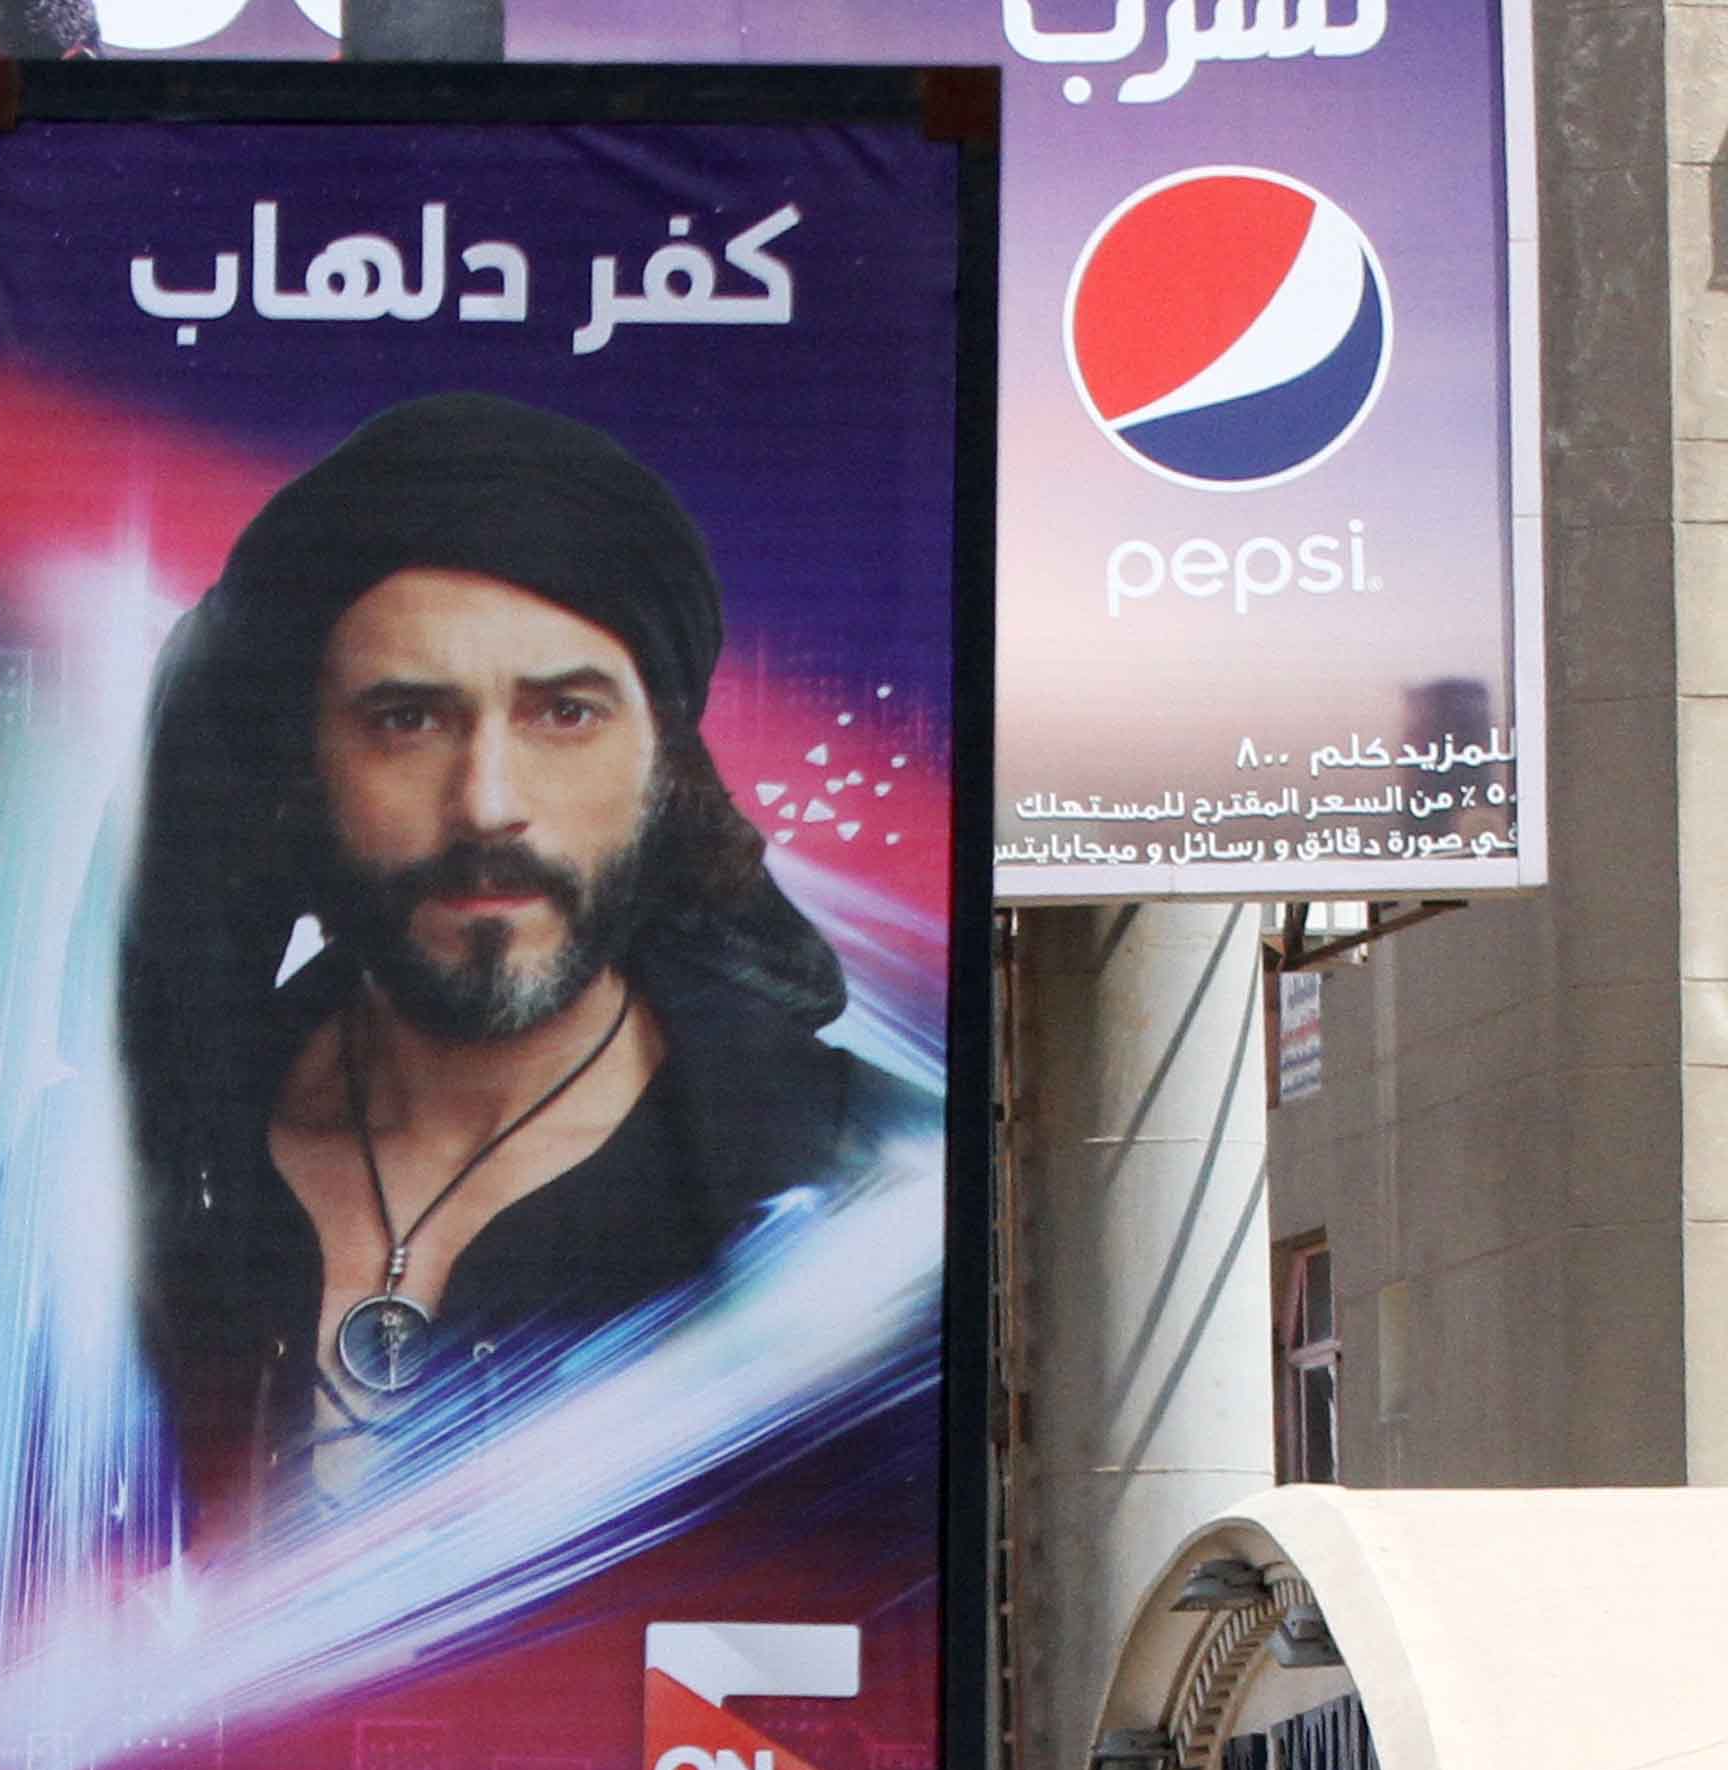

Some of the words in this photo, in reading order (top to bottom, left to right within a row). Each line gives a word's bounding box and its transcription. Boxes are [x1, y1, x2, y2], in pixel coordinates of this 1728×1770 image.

[130, 203, 530, 346] دلهاب
[573, 203, 802, 355] كفر
[1107, 518, 1370, 617] pepsi
[1310, 733, 1391, 776] كلم
[1015, 791, 1185, 821] للمستهلك
[1191, 786, 1300, 824] المقترح
[1305, 784, 1403, 819] السعر
[1410, 787, 1453, 817] من
[1169, 832, 1265, 864] رسائل
[1296, 827, 1381, 861] دقائق
[1388, 826, 1463, 858] صورة
